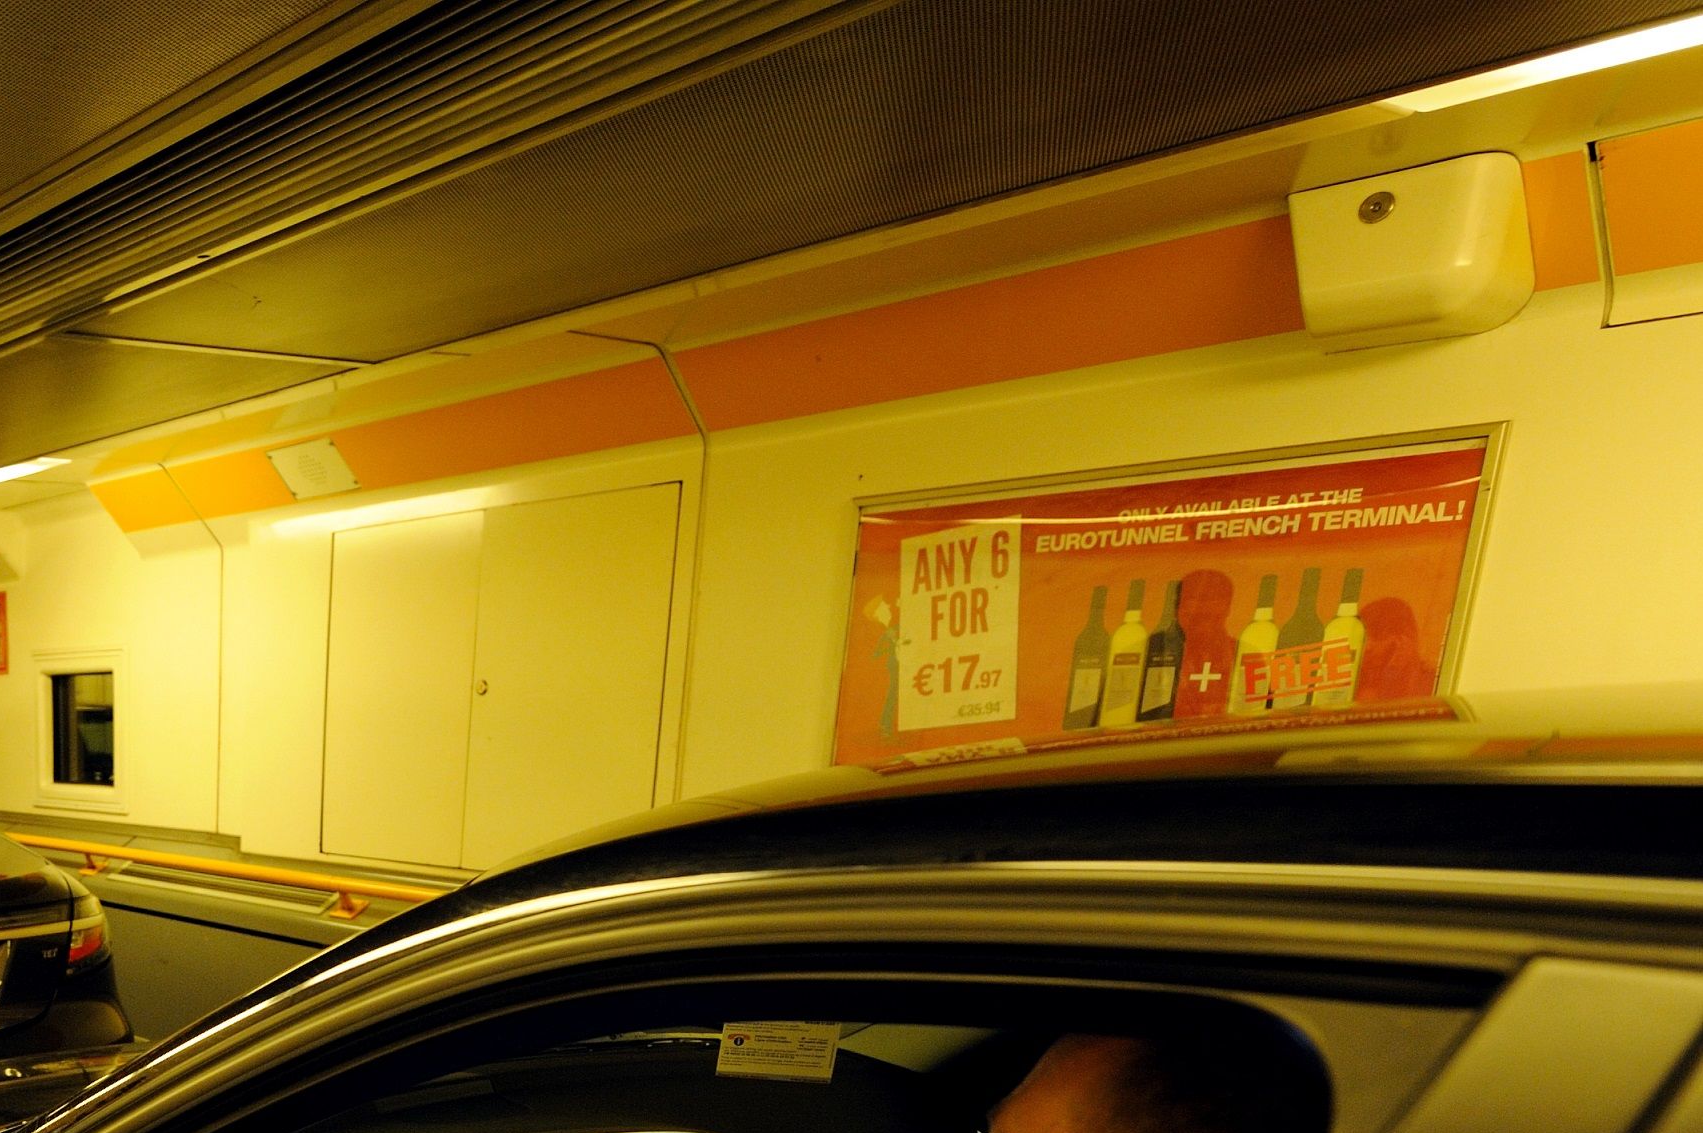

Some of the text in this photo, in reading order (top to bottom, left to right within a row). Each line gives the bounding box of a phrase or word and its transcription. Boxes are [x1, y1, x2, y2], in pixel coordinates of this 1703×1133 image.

[1035, 500, 1467, 554] EUROTUNNEL FRENCH TERMINAL!
[1118, 487, 1364, 524] ONLY AVAILABLE AT THE
[912, 530, 1010, 594] ANY 6
[930, 587, 990, 641] FOR
[911, 654, 1003, 697] €17.97
[1243, 645, 1353, 696] FREE
